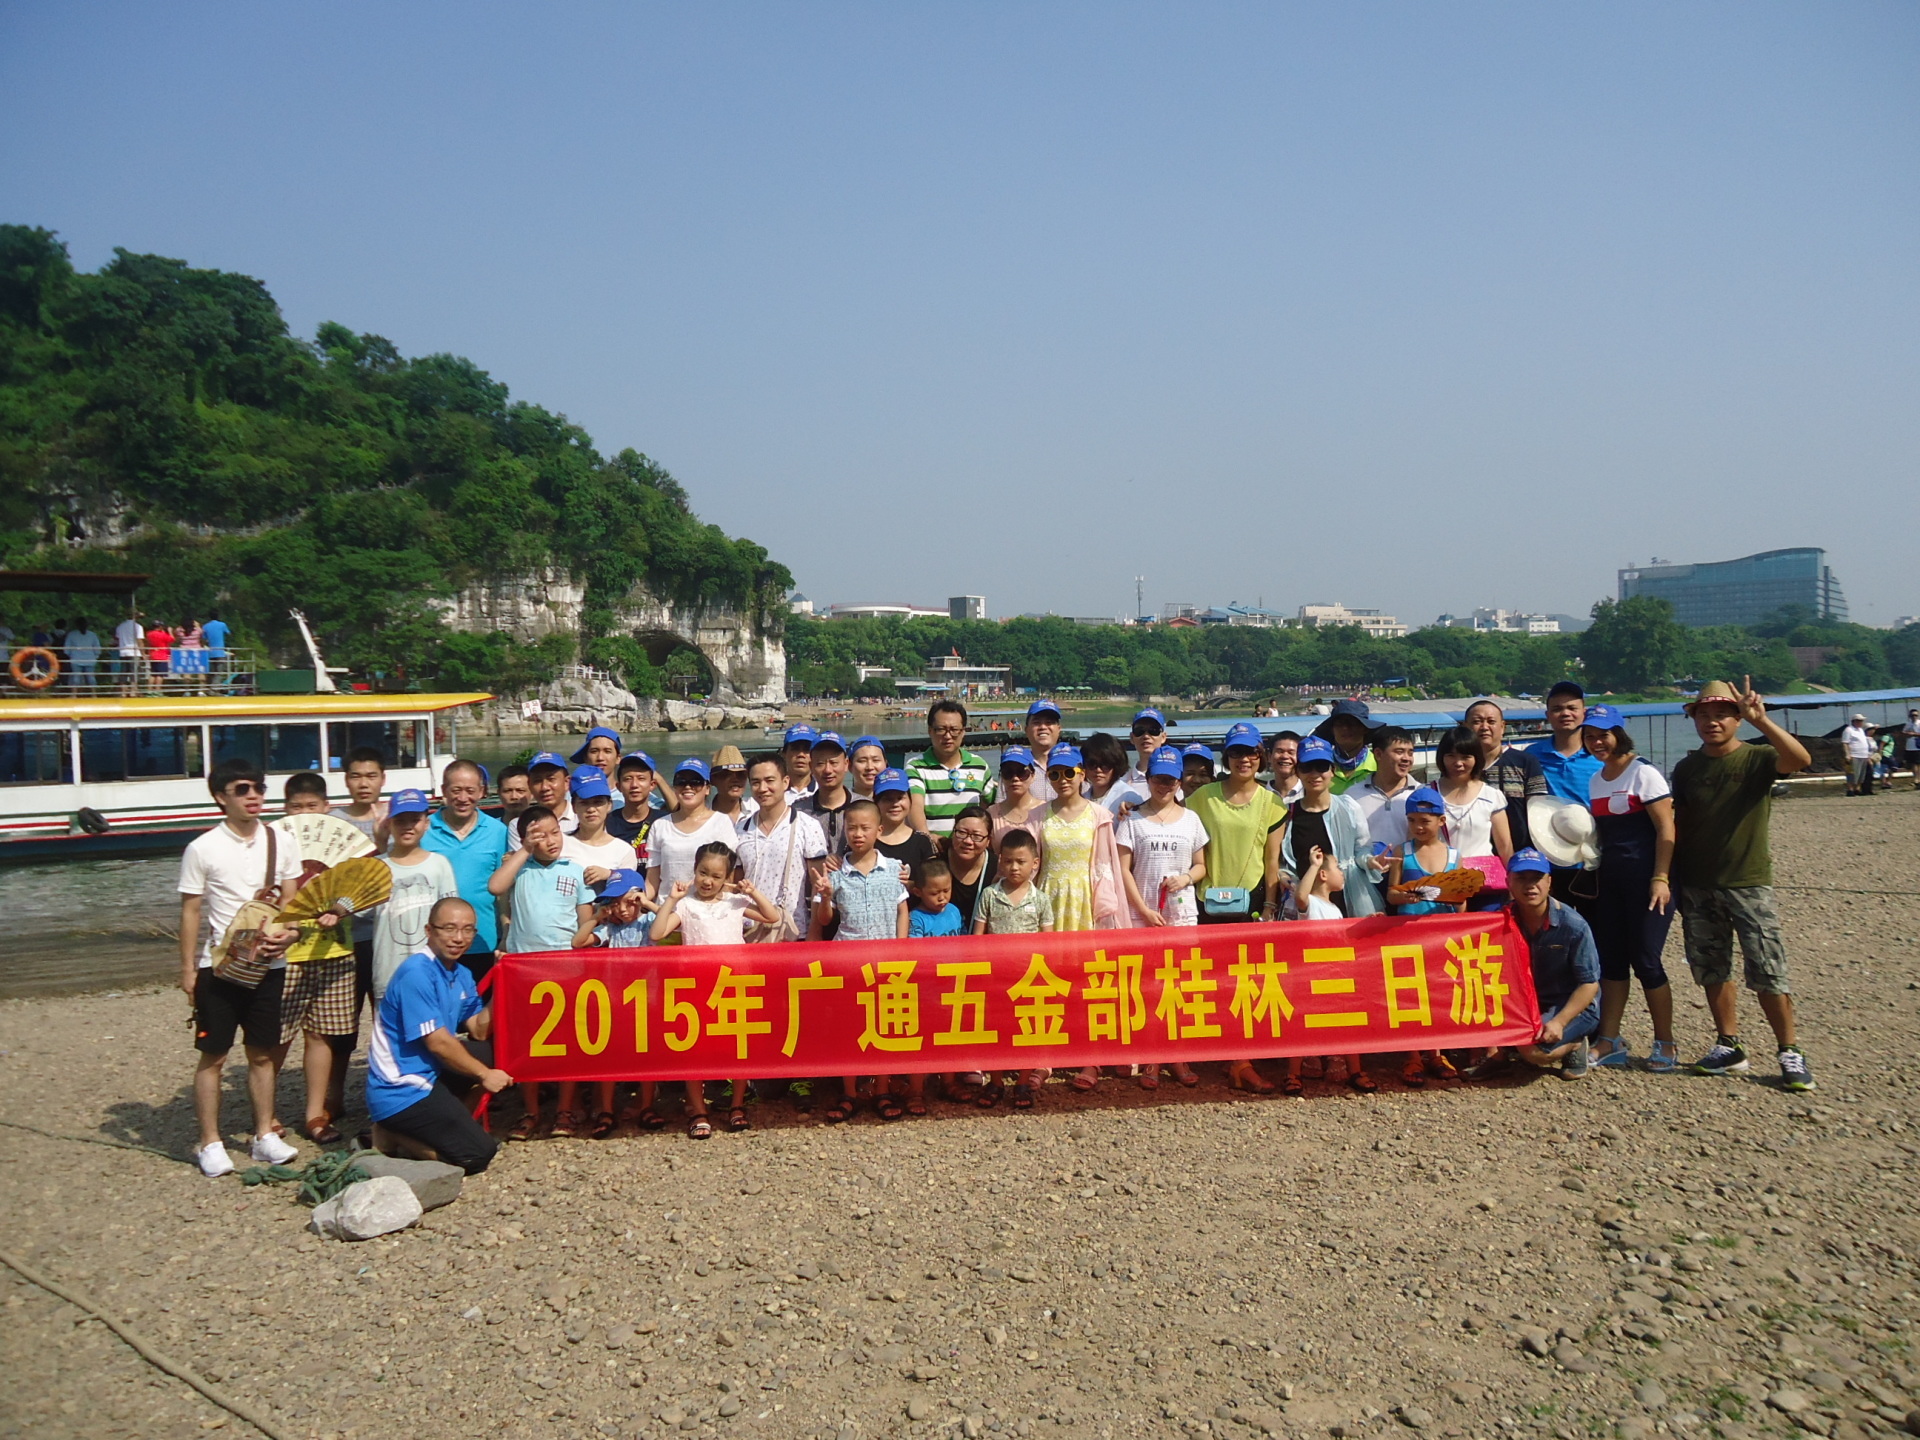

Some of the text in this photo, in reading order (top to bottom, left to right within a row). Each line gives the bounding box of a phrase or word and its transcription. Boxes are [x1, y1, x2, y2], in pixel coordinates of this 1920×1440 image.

[1150, 841, 1178, 851] MNG
[530, 932, 1509, 1059] 2015年广通五金部桂林三日游
